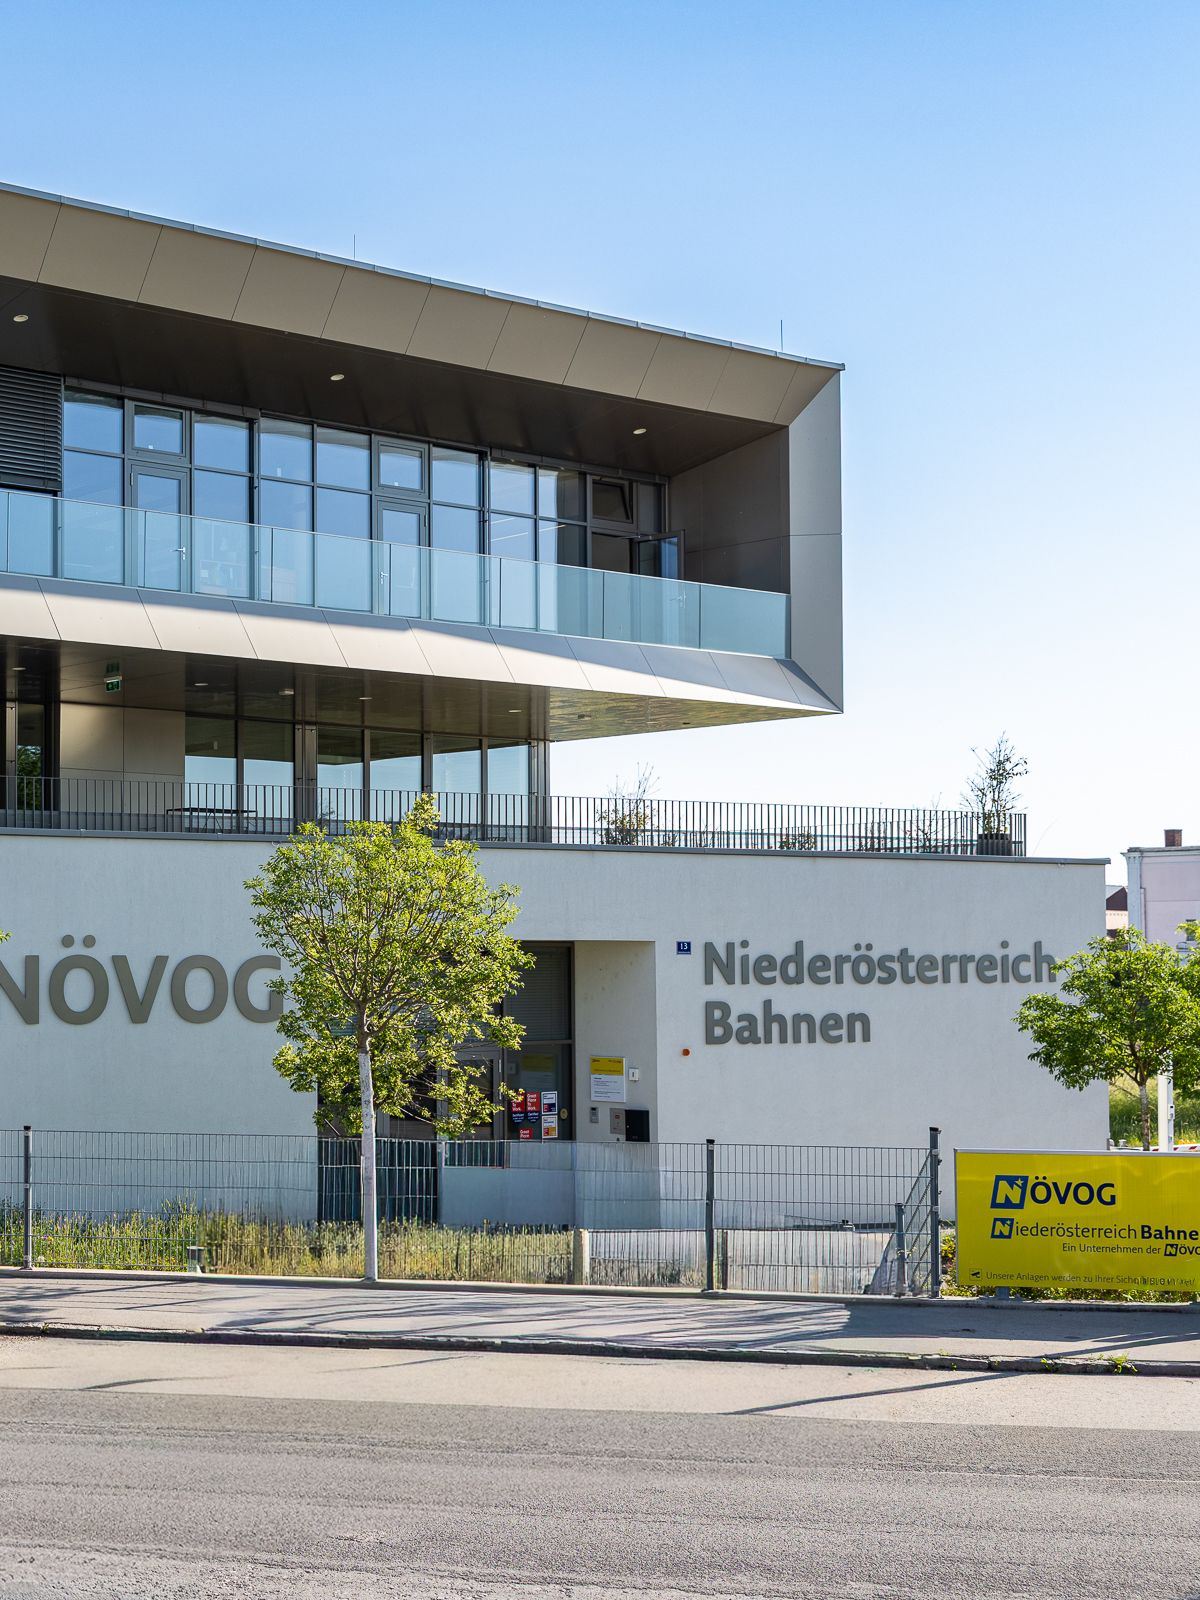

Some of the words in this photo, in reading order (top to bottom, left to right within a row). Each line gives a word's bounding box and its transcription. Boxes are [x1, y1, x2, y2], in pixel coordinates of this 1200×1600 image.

[680, 942, 688, 950] 13
[704, 939, 1057, 986] Niederösterreich
[705, 999, 871, 1045] Bahnen
[990, 1175, 1116, 1209] NÖVOG
[991, 1218, 1137, 1239] Niederösterreich
[1141, 1225, 1199, 1240] Bahne
[1062, 1243, 1076, 1252] Ein
[1080, 1244, 1143, 1254] Unternehmen
[1146, 1245, 1161, 1254] der
[986, 1271, 1014, 1280] Unsere
[1017, 1272, 1049, 1282] Anlagen
[1052, 1273, 1081, 1282] werden
